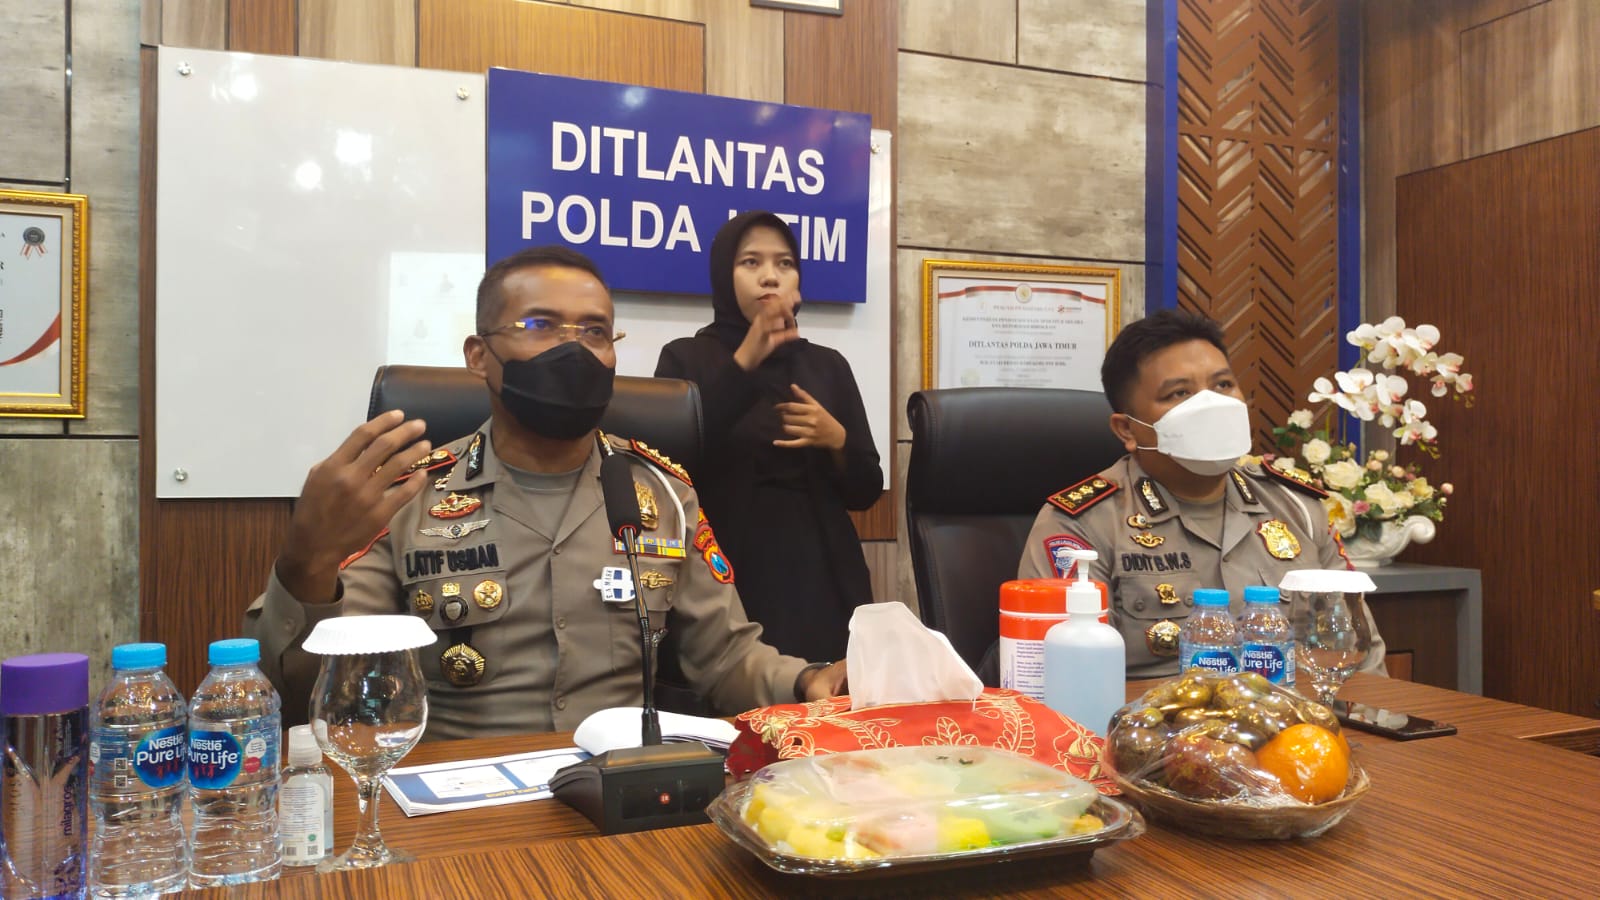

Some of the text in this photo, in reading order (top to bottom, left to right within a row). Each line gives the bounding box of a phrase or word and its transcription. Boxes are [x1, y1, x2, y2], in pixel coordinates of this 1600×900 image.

[552, 121, 825, 195] DITLANTAS
[522, 191, 702, 252] POLDA
[968, 341, 1009, 349] DITLANTAS
[1010, 341, 1033, 349] POLDA
[1034, 342, 1053, 350] JAWA
[406, 543, 499, 578] LATIF USMAN
[1121, 552, 1153, 571] DIDIT
[1244, 659, 1283, 672] ure Life
[136, 749, 174, 766] Pure
[190, 750, 238, 770] ure Life
[61, 784, 74, 836] milagros
